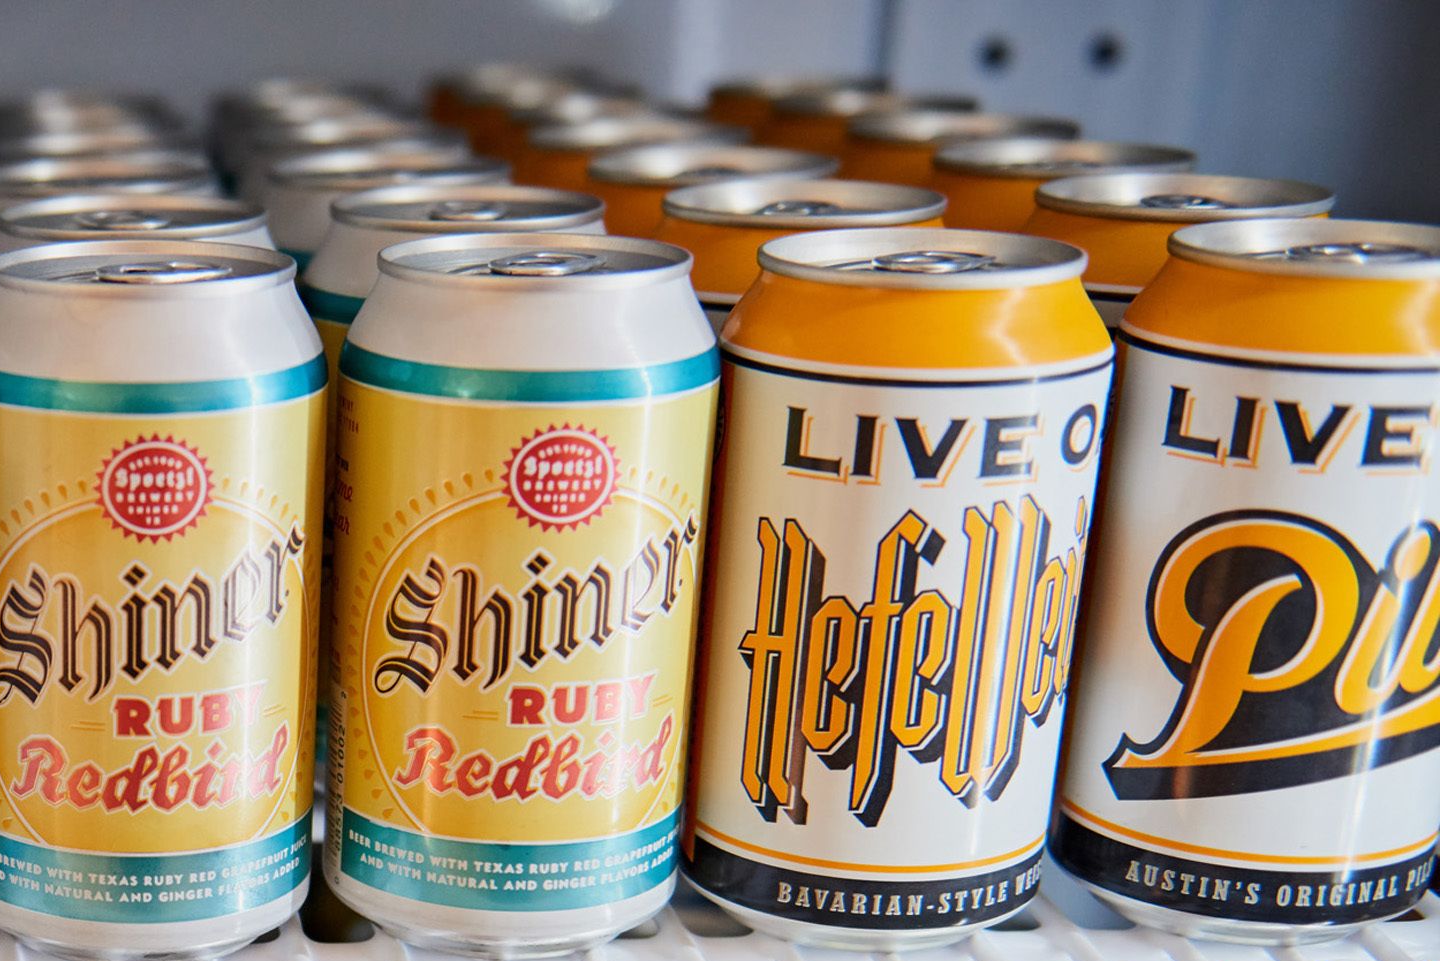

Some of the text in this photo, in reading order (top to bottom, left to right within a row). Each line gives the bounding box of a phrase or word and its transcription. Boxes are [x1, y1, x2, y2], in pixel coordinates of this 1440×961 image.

[782, 405, 1042, 487] LIVE
[1162, 385, 1437, 475] LIVE
[373, 513, 698, 694] Shiner
[112, 684, 264, 738] RUBY
[507, 671, 655, 725] RUBY
[11, 720, 289, 814] Redbird
[394, 712, 673, 800] Redbird
[46, 866, 83, 883] WITH
[88, 873, 138, 887] TEXAS
[143, 873, 184, 886] RUBY
[190, 869, 217, 883] RED
[221, 847, 289, 881] GRAPEFRUIT
[349, 829, 371, 849] BEER
[374, 837, 425, 864] BREWED
[429, 855, 468, 871] WITH
[473, 860, 524, 875] TEXAS
[529, 860, 568, 875] RUBY
[574, 856, 601, 872] RED
[605, 835, 668, 868] GRAPEFRUIT
[360, 853, 384, 871] AND
[386, 862, 422, 879] WITH
[426, 872, 498, 891] NATURAL
[503, 877, 538, 891] AND
[542, 874, 597, 891] GINGER
[600, 860, 649, 886] FLAVORS
[9, 875, 40, 892] WITH
[44, 883, 113, 903] NATURAL
[119, 891, 153, 903] AND
[159, 886, 214, 903] GINGER
[777, 881, 1008, 916] BAVARIAN-STYLE
[1125, 860, 1261, 905] AUSTIN'S
[1275, 876, 1398, 907] ORIGINAL
